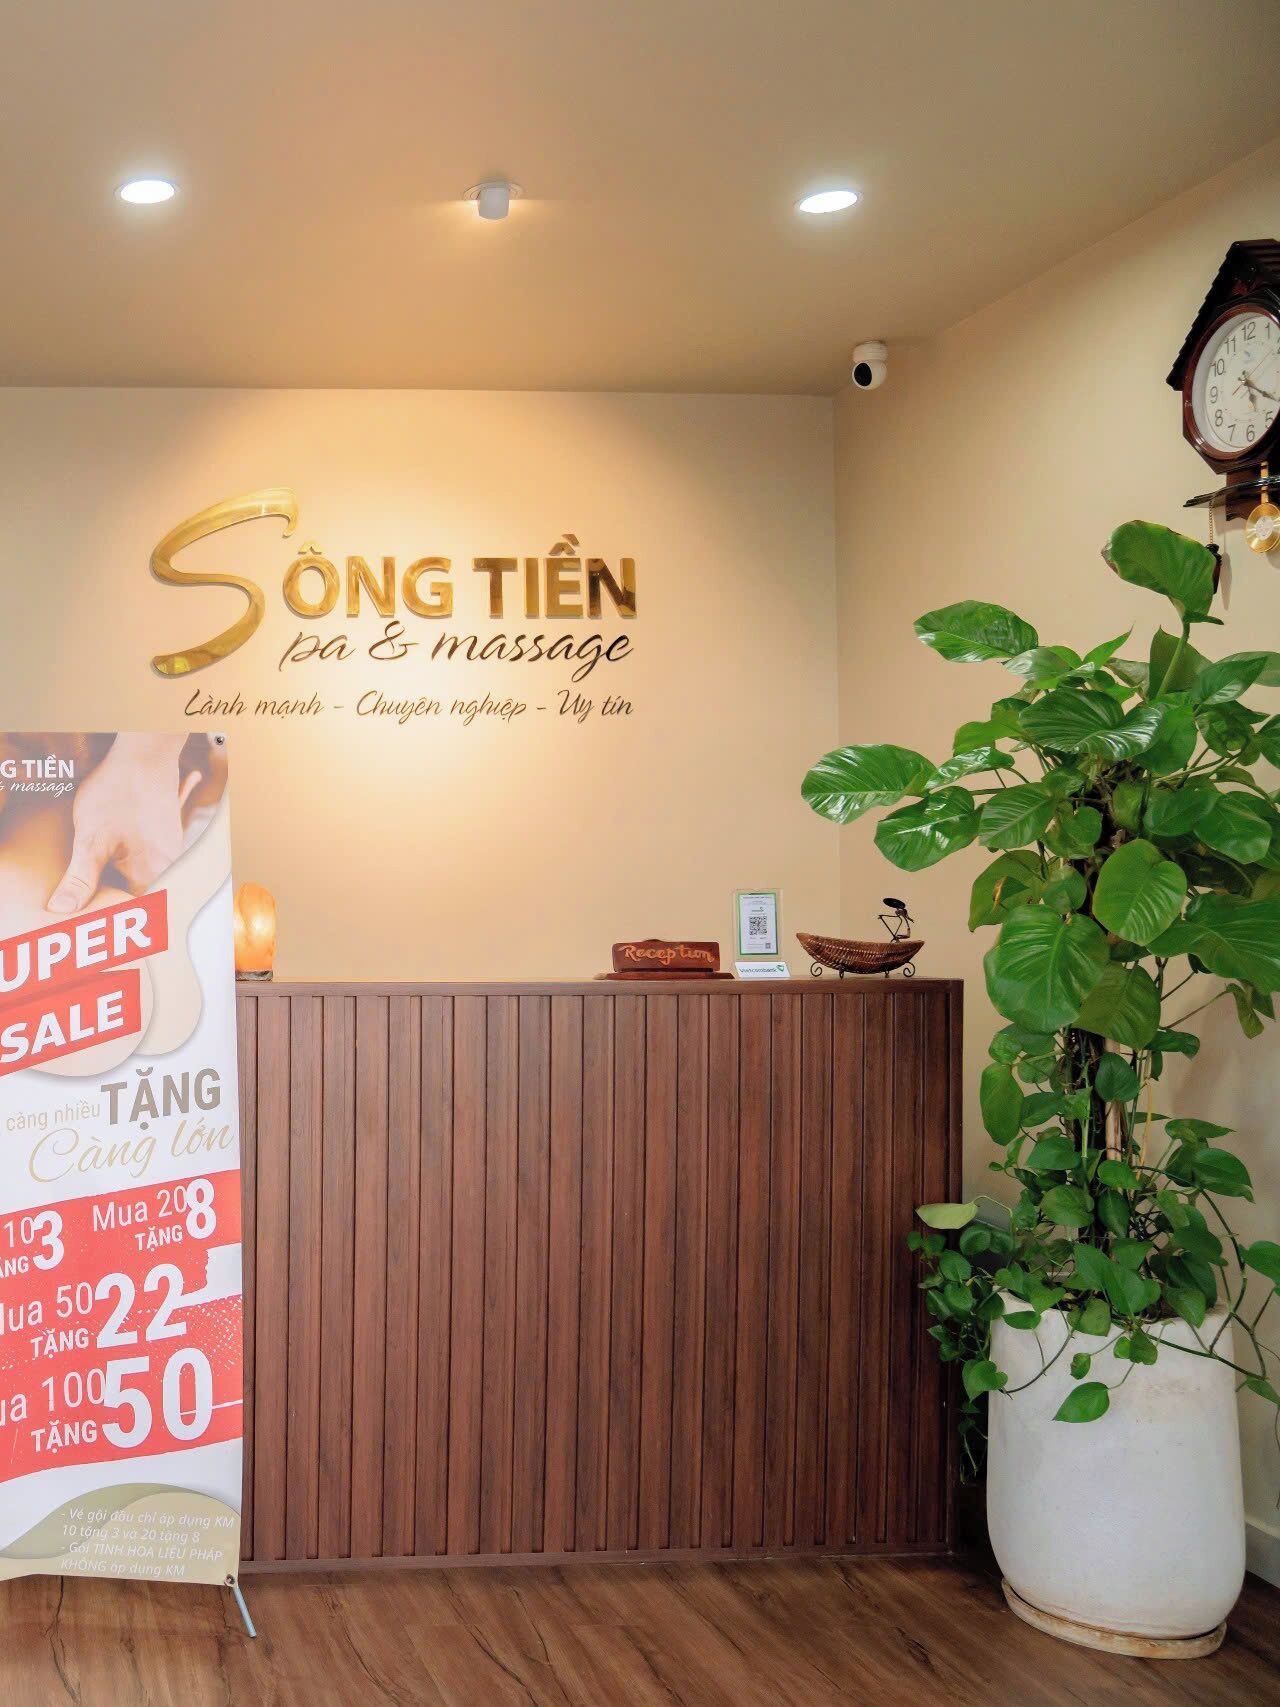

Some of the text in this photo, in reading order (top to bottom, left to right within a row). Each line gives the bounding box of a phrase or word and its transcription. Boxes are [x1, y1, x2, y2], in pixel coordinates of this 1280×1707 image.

[1241, 321, 1256, 341] 12
[1264, 322, 1270, 339] 1
[1225, 335, 1236, 355] 11
[1209, 358, 1225, 377] 10
[1210, 386, 1218, 404] 9
[1214, 409, 1224, 427] 8
[1227, 423, 1236, 442] 7
[1246, 424, 1255, 442] 6
[473, 533, 637, 618] TIỀN
[368, 620, 420, 661] &
[432, 630, 634, 682] massage
[184, 689, 248, 717] Lành
[255, 692, 326, 718] mạnh
[356, 690, 443, 726] Chuyên
[450, 692, 527, 726] nghiệp
[557, 689, 594, 726] Uy
[601, 692, 634, 716] tín
[22, 754, 75, 778] TIỀN
[10, 781, 75, 798] massage
[617, 944, 715, 966] Reception
[0, 990, 125, 1064] SALE
[6, 1108, 49, 1131] càng
[54, 1100, 101, 1125] nhiều
[101, 1066, 221, 1130] TẶNG
[28, 1117, 234, 1183] Càng lớn
[92, 1186, 187, 1232] Mua 20
[135, 1178, 217, 1253] TẶNG 8
[4, 1216, 35, 1249] 10
[32, 1210, 65, 1271] 3
[30, 1264, 187, 1359] TẶNG 22
[56, 1282, 93, 1318] 50
[31, 1347, 213, 1454] TẶNG 50
[42, 1368, 106, 1412] 100
[63, 1524, 76, 1536] 10
[112, 1527, 120, 1539] 3
[140, 1529, 157, 1541] 20
[192, 1532, 201, 1543] 8
[215, 1516, 235, 1529] KM
[165, 1564, 185, 1577] KM
